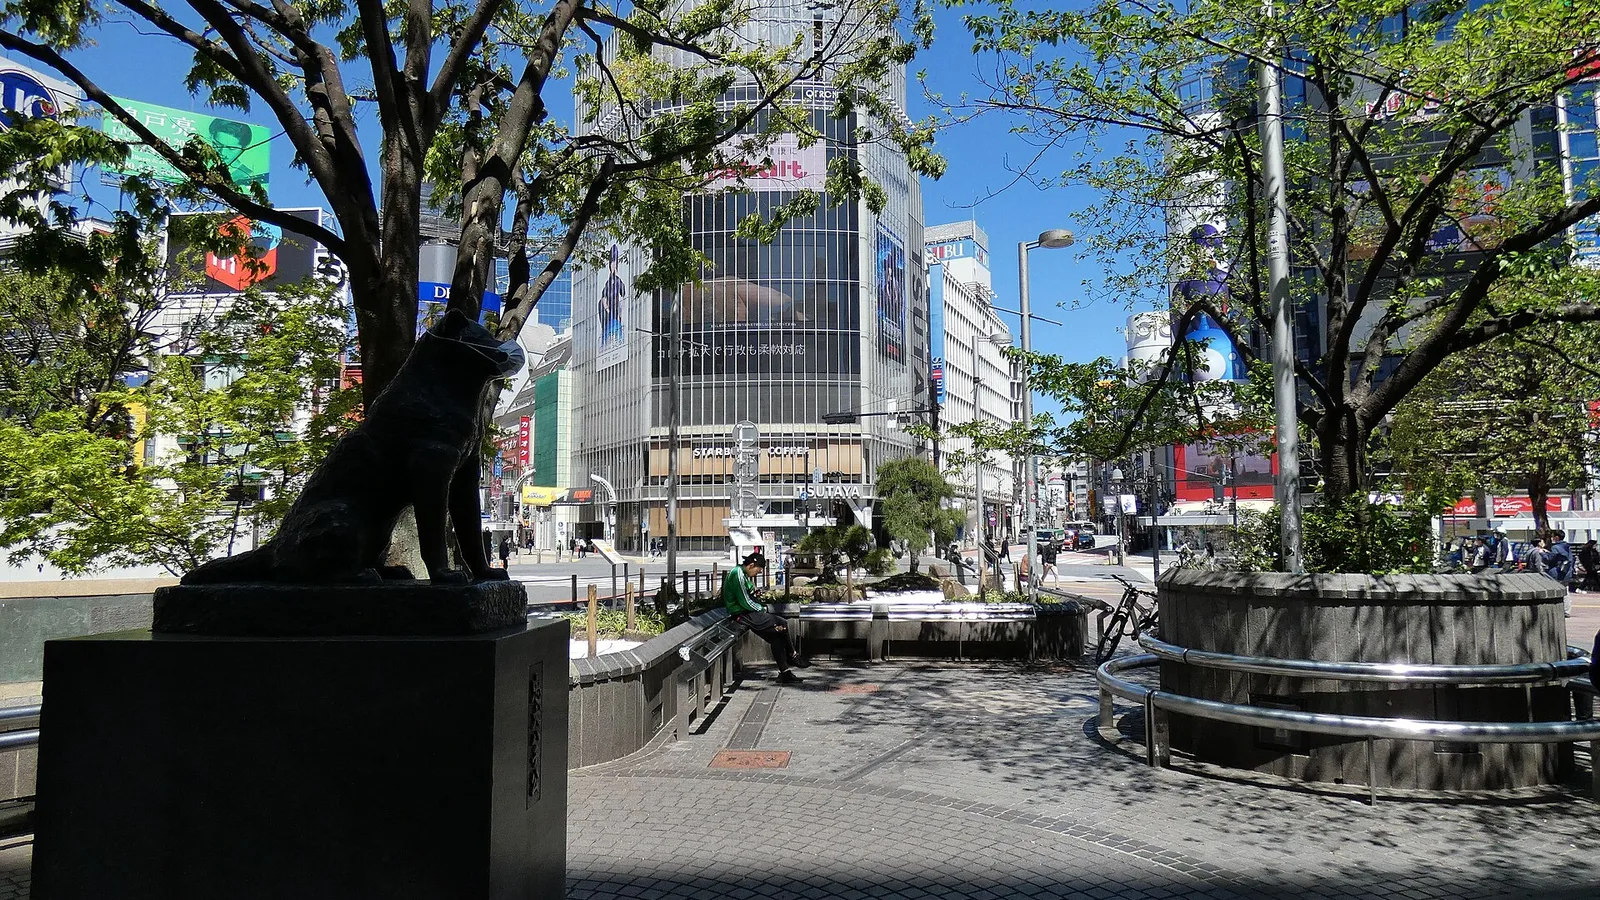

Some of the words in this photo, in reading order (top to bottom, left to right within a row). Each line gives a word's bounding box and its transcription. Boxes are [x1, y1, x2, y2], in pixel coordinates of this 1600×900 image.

[657, 344, 805, 358] コナ拡大で行政も柔軟対応
[797, 485, 861, 498] TSUTAYA
